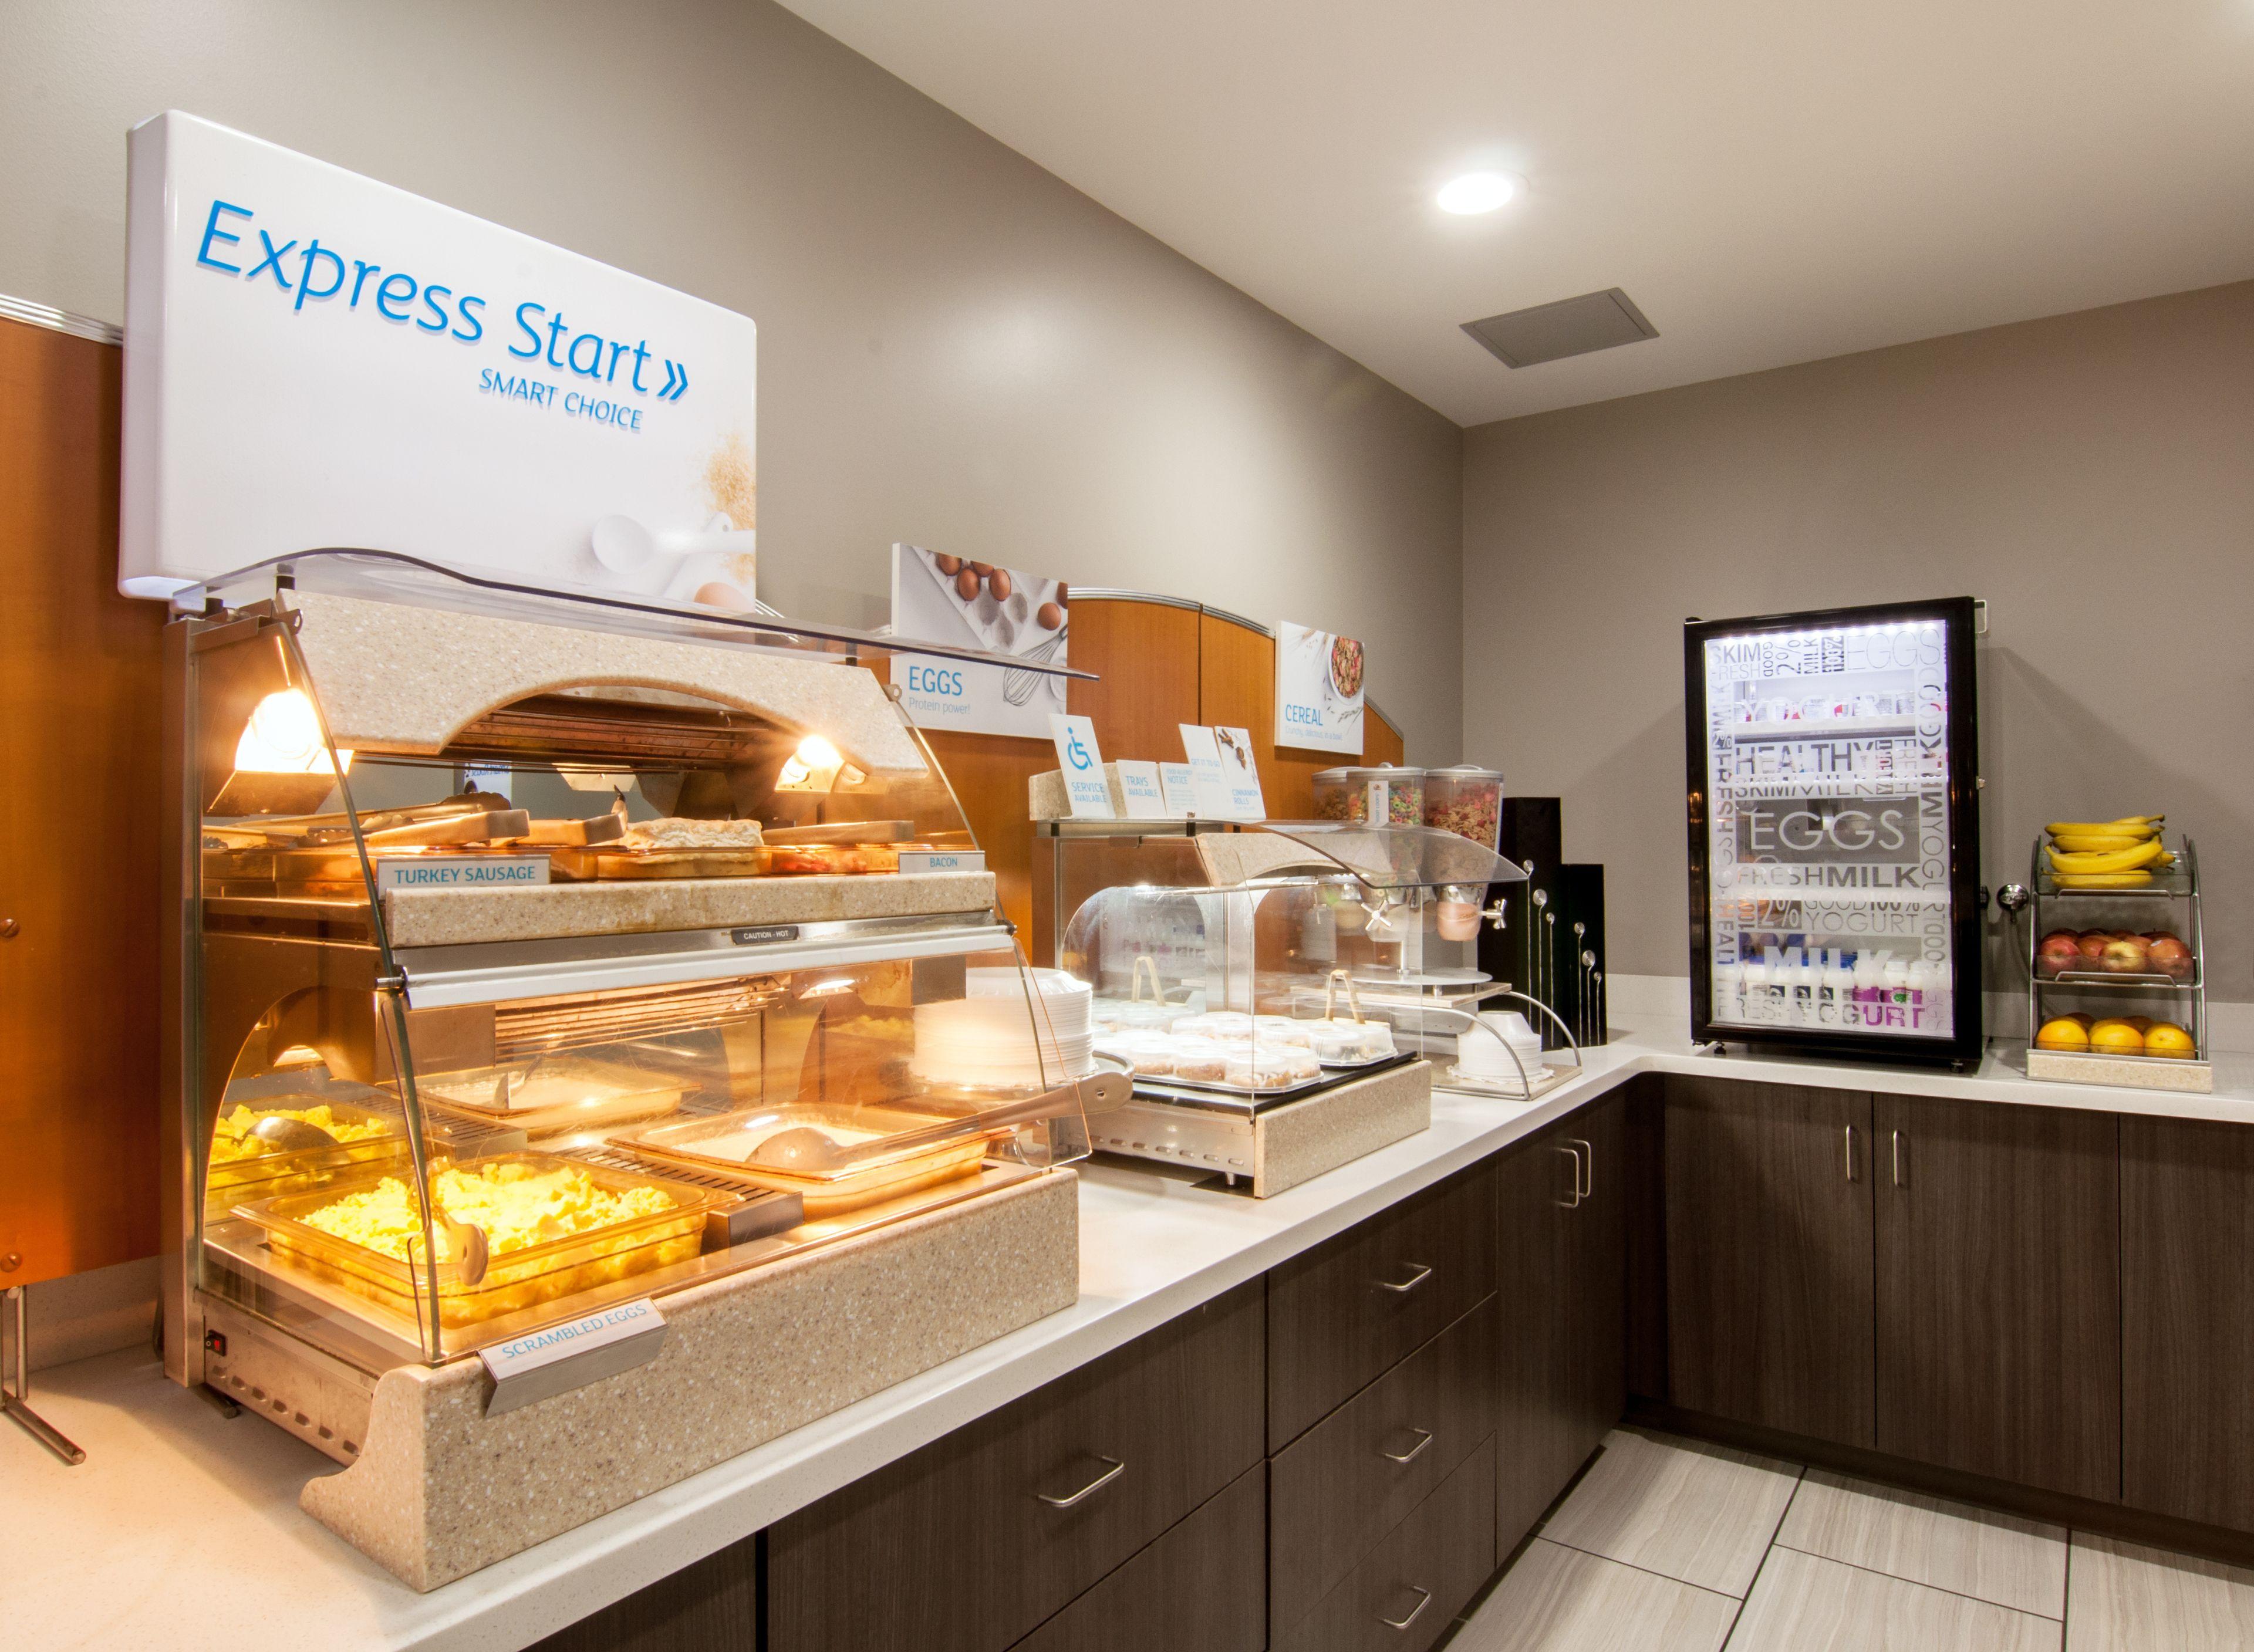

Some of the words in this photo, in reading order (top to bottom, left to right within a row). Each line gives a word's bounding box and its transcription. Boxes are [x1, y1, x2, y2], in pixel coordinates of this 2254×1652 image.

[196, 200, 486, 342] Express
[508, 301, 652, 393] Start
[479, 367, 558, 406] SMART
[564, 391, 643, 430] CHOICE
[1710, 643, 1760, 664] SKIM
[1848, 629, 1941, 671] EGGS
[909, 665, 963, 696] EGGS
[1710, 663, 1760, 681] RESH
[909, 697, 939, 710] Protein
[942, 702, 970, 715] power!
[1285, 704, 1323, 726] CEREAL
[1741, 690, 1907, 726] YOGURT
[1071, 782, 1104, 793] SERVICE
[1126, 776, 1149, 786] TRAYS
[1075, 794, 1107, 803] AVAILABLE
[1128, 788, 1159, 798] AVAILABLE
[1750, 810, 1905, 850] EGGS
[930, 857, 958, 867] BACON
[394, 868, 460, 884] TURKEY
[464, 866, 535, 881] SAUSAGE
[1737, 866, 1823, 885] FRESH
[1827, 866, 1921, 888] MILK
[1806, 911, 1919, 933] YOGURT
[744, 931, 772, 940] CAUTION
[1764, 946, 1896, 988] MILK
[502, 1317, 604, 1359] SCRAMBLED
[605, 1304, 647, 1325] EGGS
